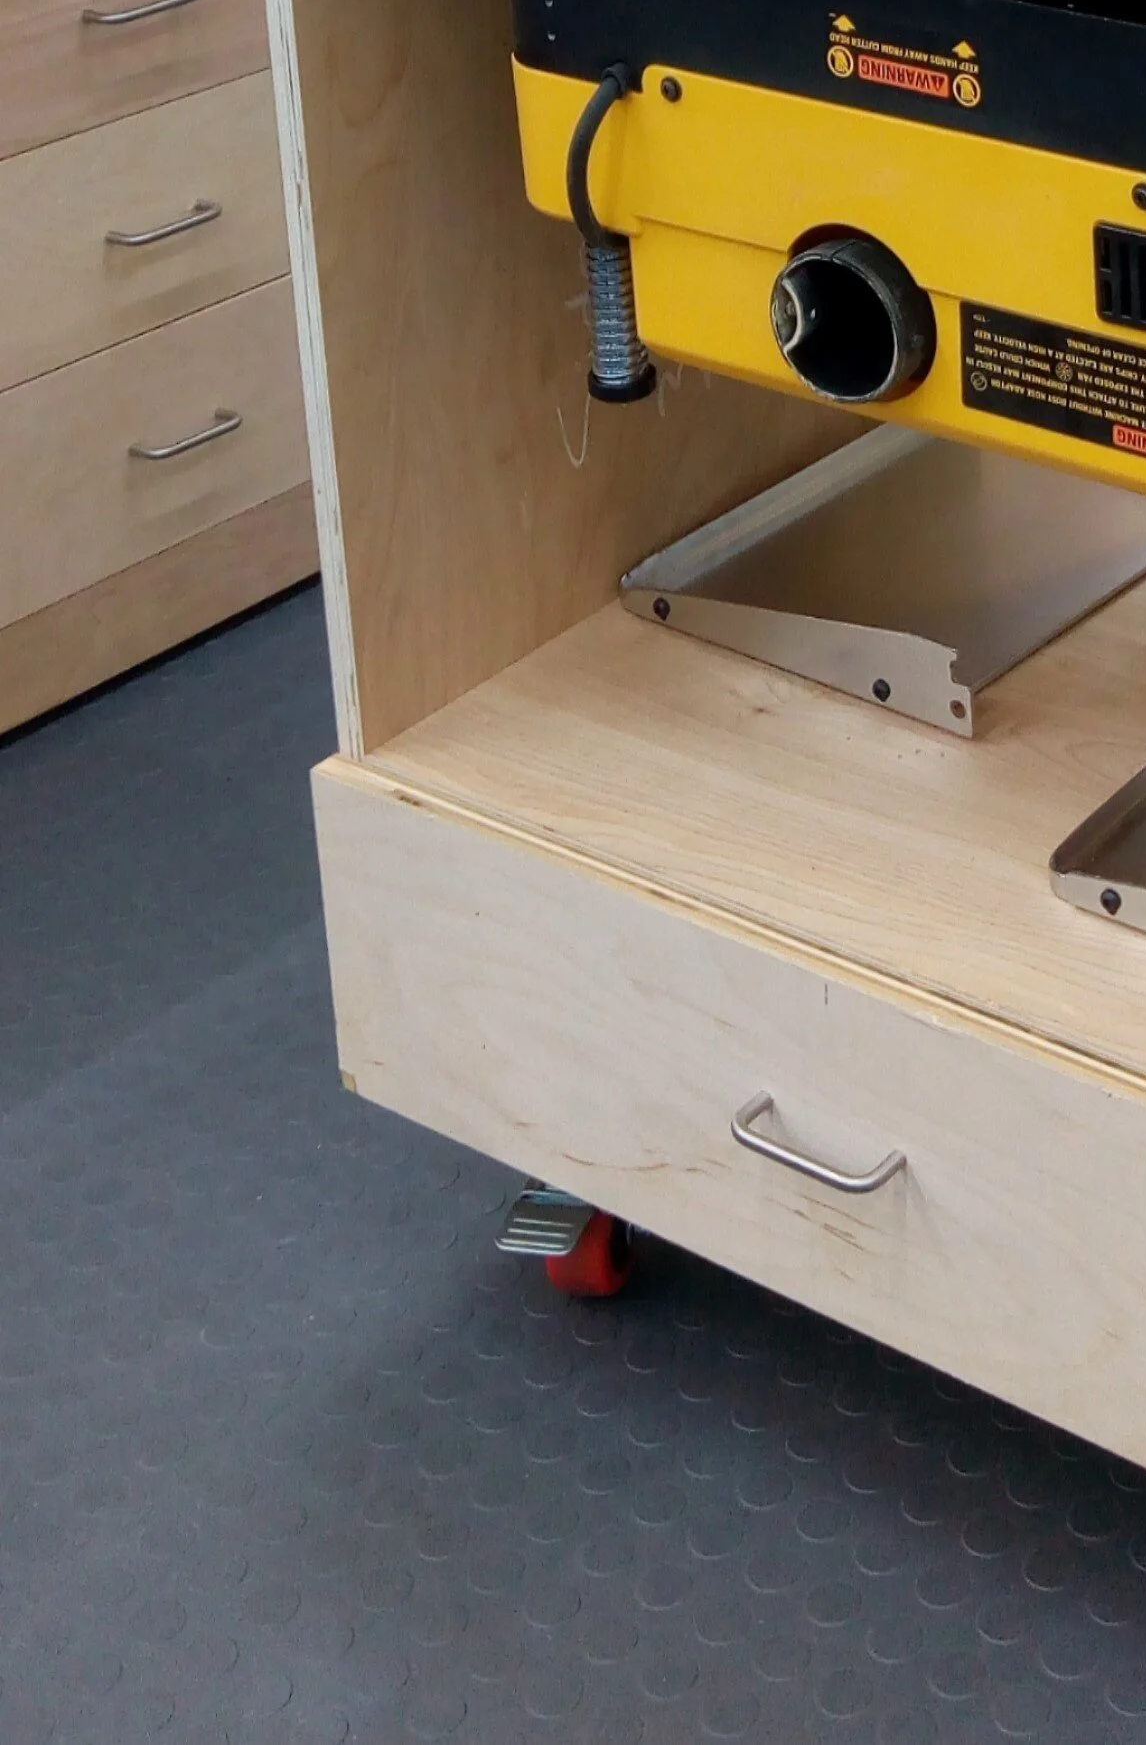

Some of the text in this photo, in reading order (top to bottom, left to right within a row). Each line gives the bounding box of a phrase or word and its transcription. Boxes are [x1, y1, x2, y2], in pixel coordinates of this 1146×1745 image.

[851, 36, 880, 52] CUTTER
[881, 43, 904, 58] FROM
[904, 49, 928, 62] AWAY
[930, 56, 958, 70] HANDS
[959, 62, 980, 74] KEEP
[861, 58, 931, 90] WARNING
